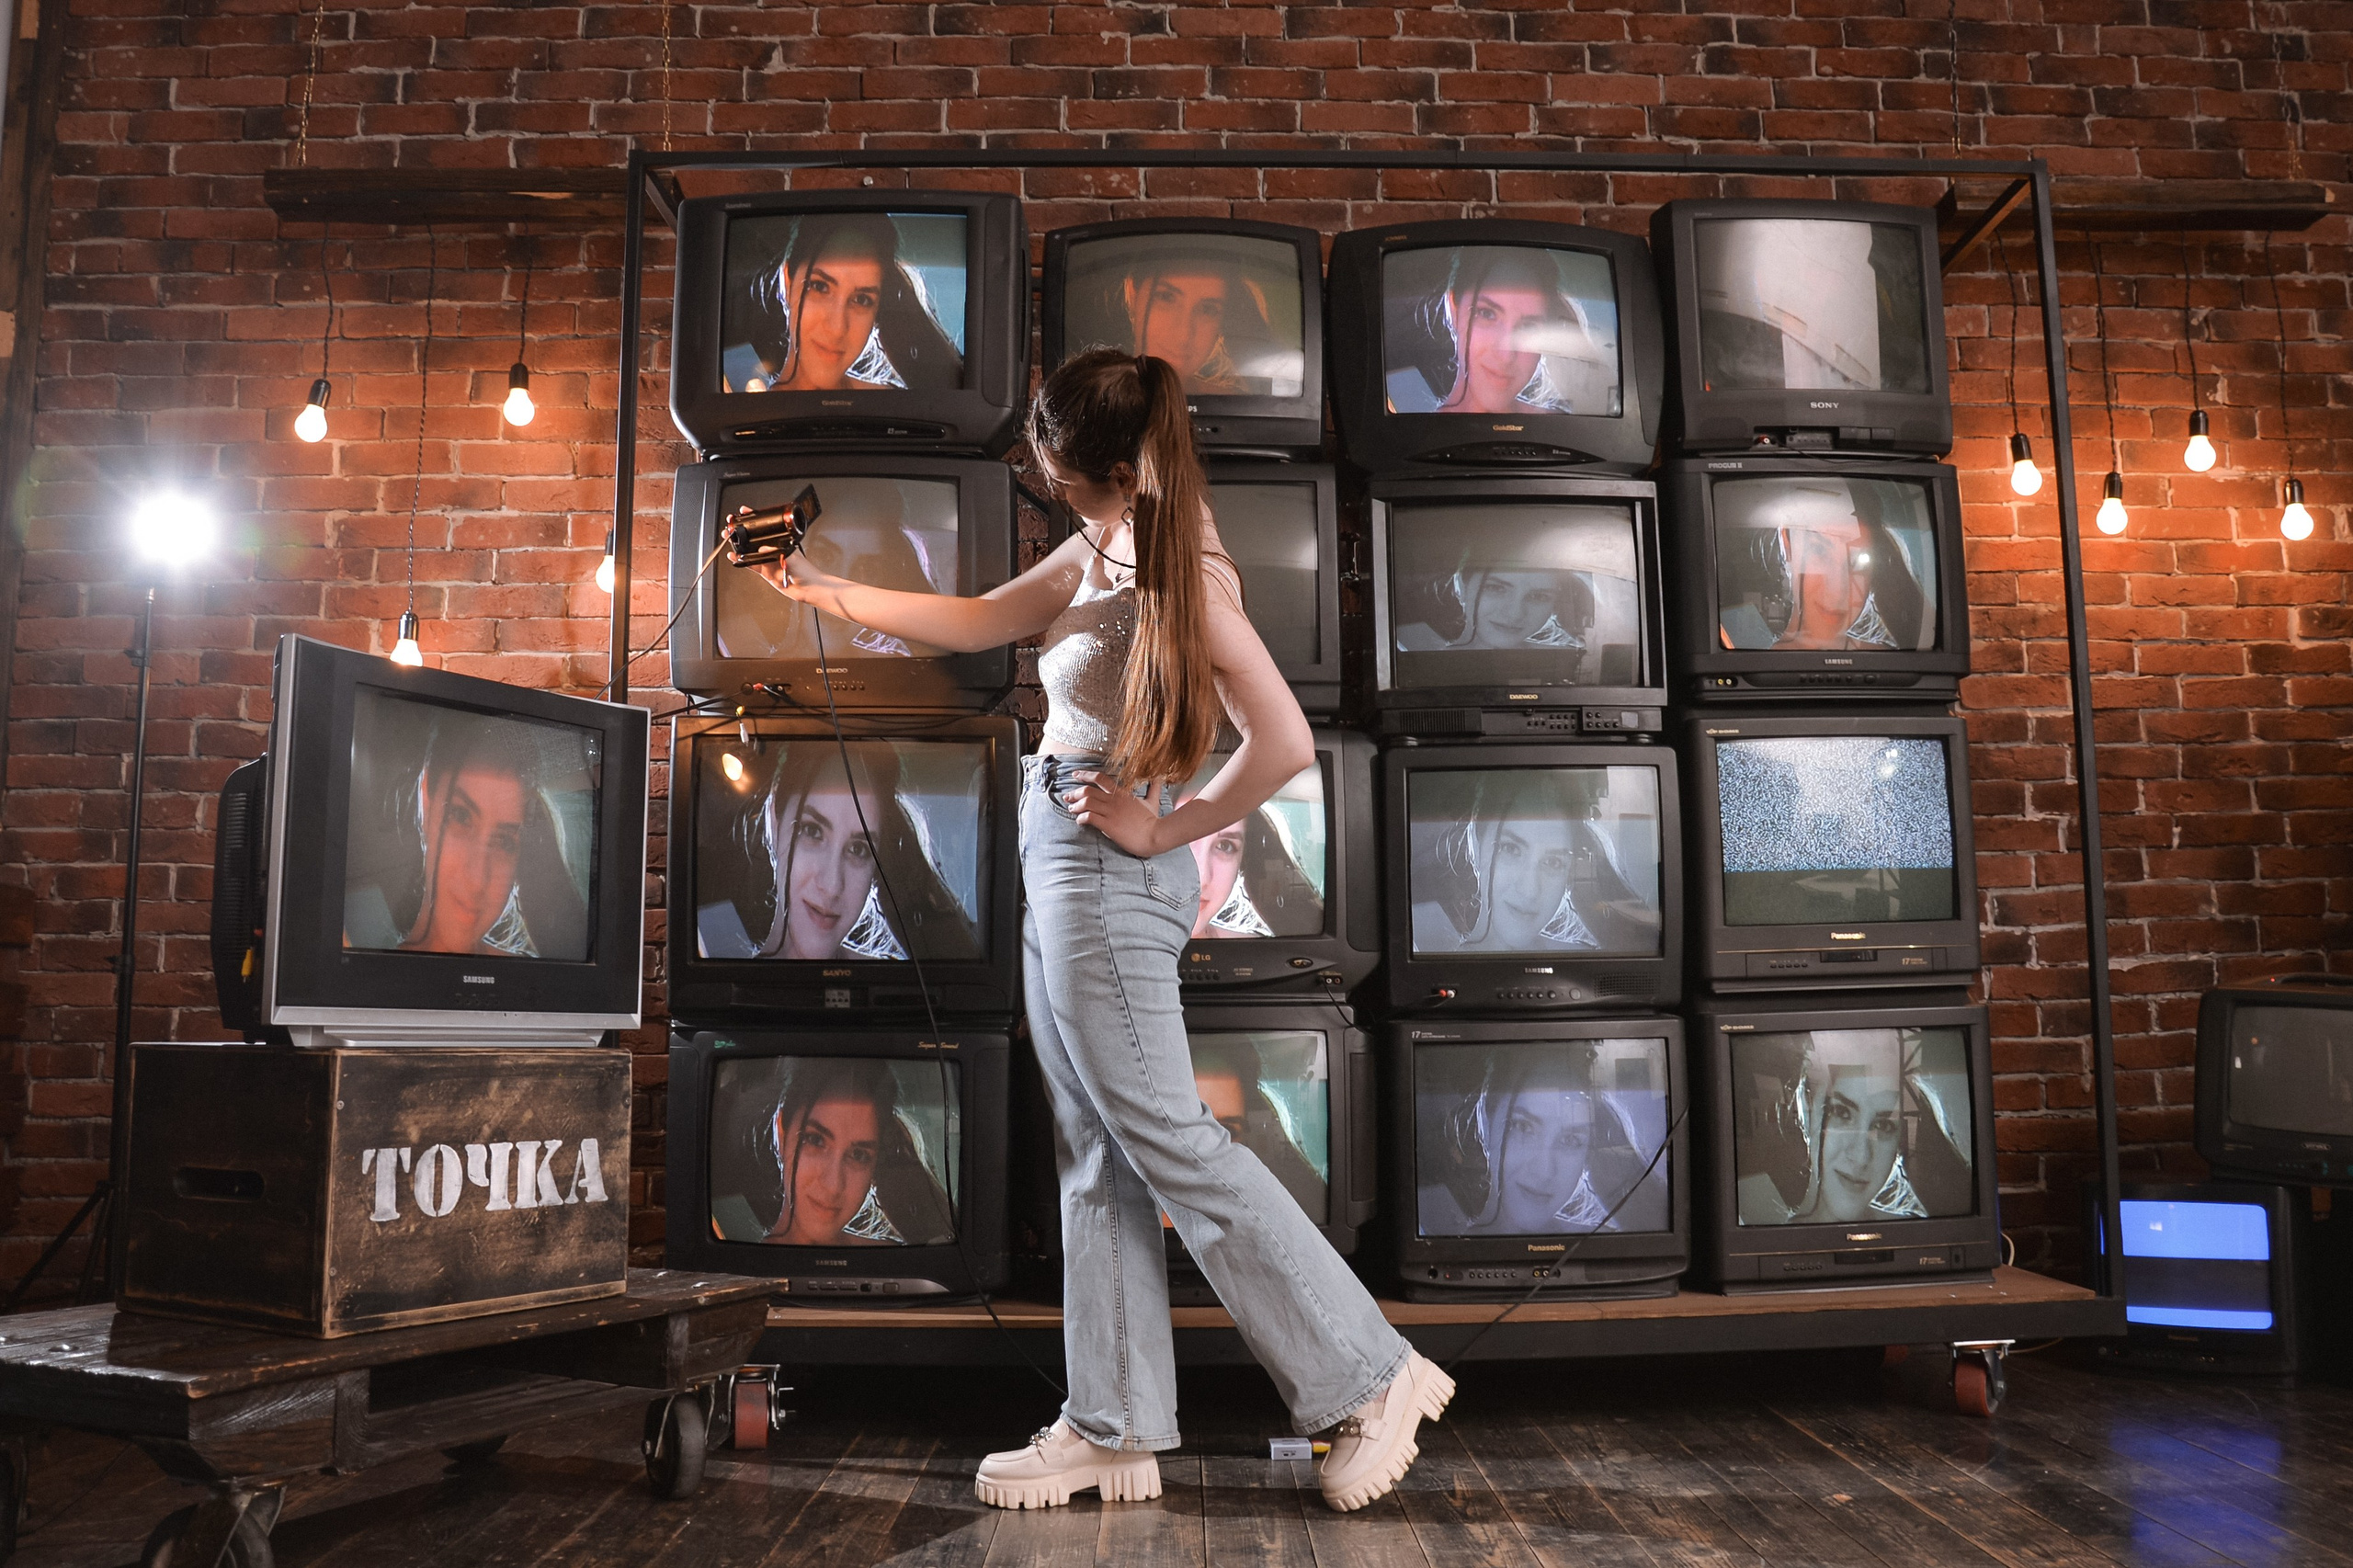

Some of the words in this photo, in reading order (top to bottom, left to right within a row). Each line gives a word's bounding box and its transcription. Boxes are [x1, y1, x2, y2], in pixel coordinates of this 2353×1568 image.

[1902, 957, 1910, 965] 17
[462, 975, 495, 984] SAMSUNG
[1411, 1030, 1421, 1039] 17
[361, 1138, 609, 1222] ТОЧКА
[1847, 1233, 1882, 1241] Panasonic
